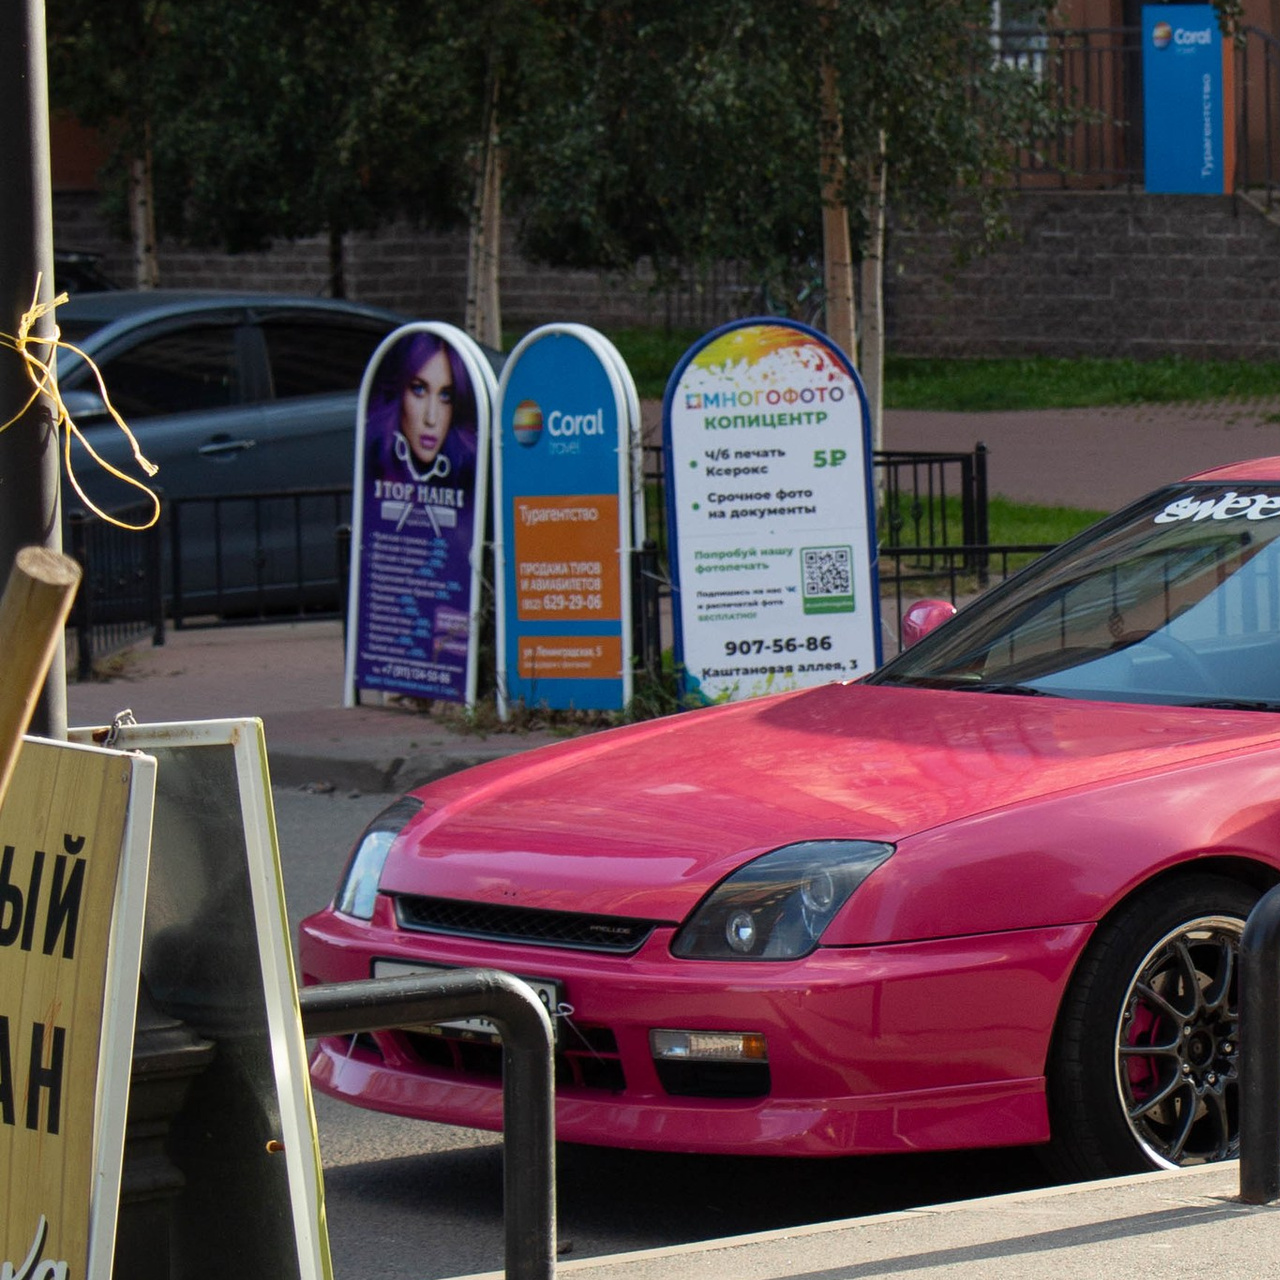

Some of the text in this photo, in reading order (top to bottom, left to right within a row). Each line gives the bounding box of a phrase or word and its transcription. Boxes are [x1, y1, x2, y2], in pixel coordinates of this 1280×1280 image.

[1174, 28, 1212, 45] Coral
[703, 386, 845, 409] МНОГОФОТО
[548, 408, 605, 437] Coral
[704, 410, 828, 431] КОПИЦЕНТР
[734, 449, 786, 460] печать
[706, 466, 769, 477] Ксерокс
[707, 488, 813, 505] Срочное фото
[519, 505, 599, 526] Турагентство
[708, 505, 816, 520] на документы
[694, 547, 794, 561] Попробуй нашу
[570, 561, 602, 575] ТУРОВ
[695, 562, 769, 575] фотопечать
[725, 636, 832, 656] 907-56-86
[702, 659, 858, 680] Каштановая аллея, 3
